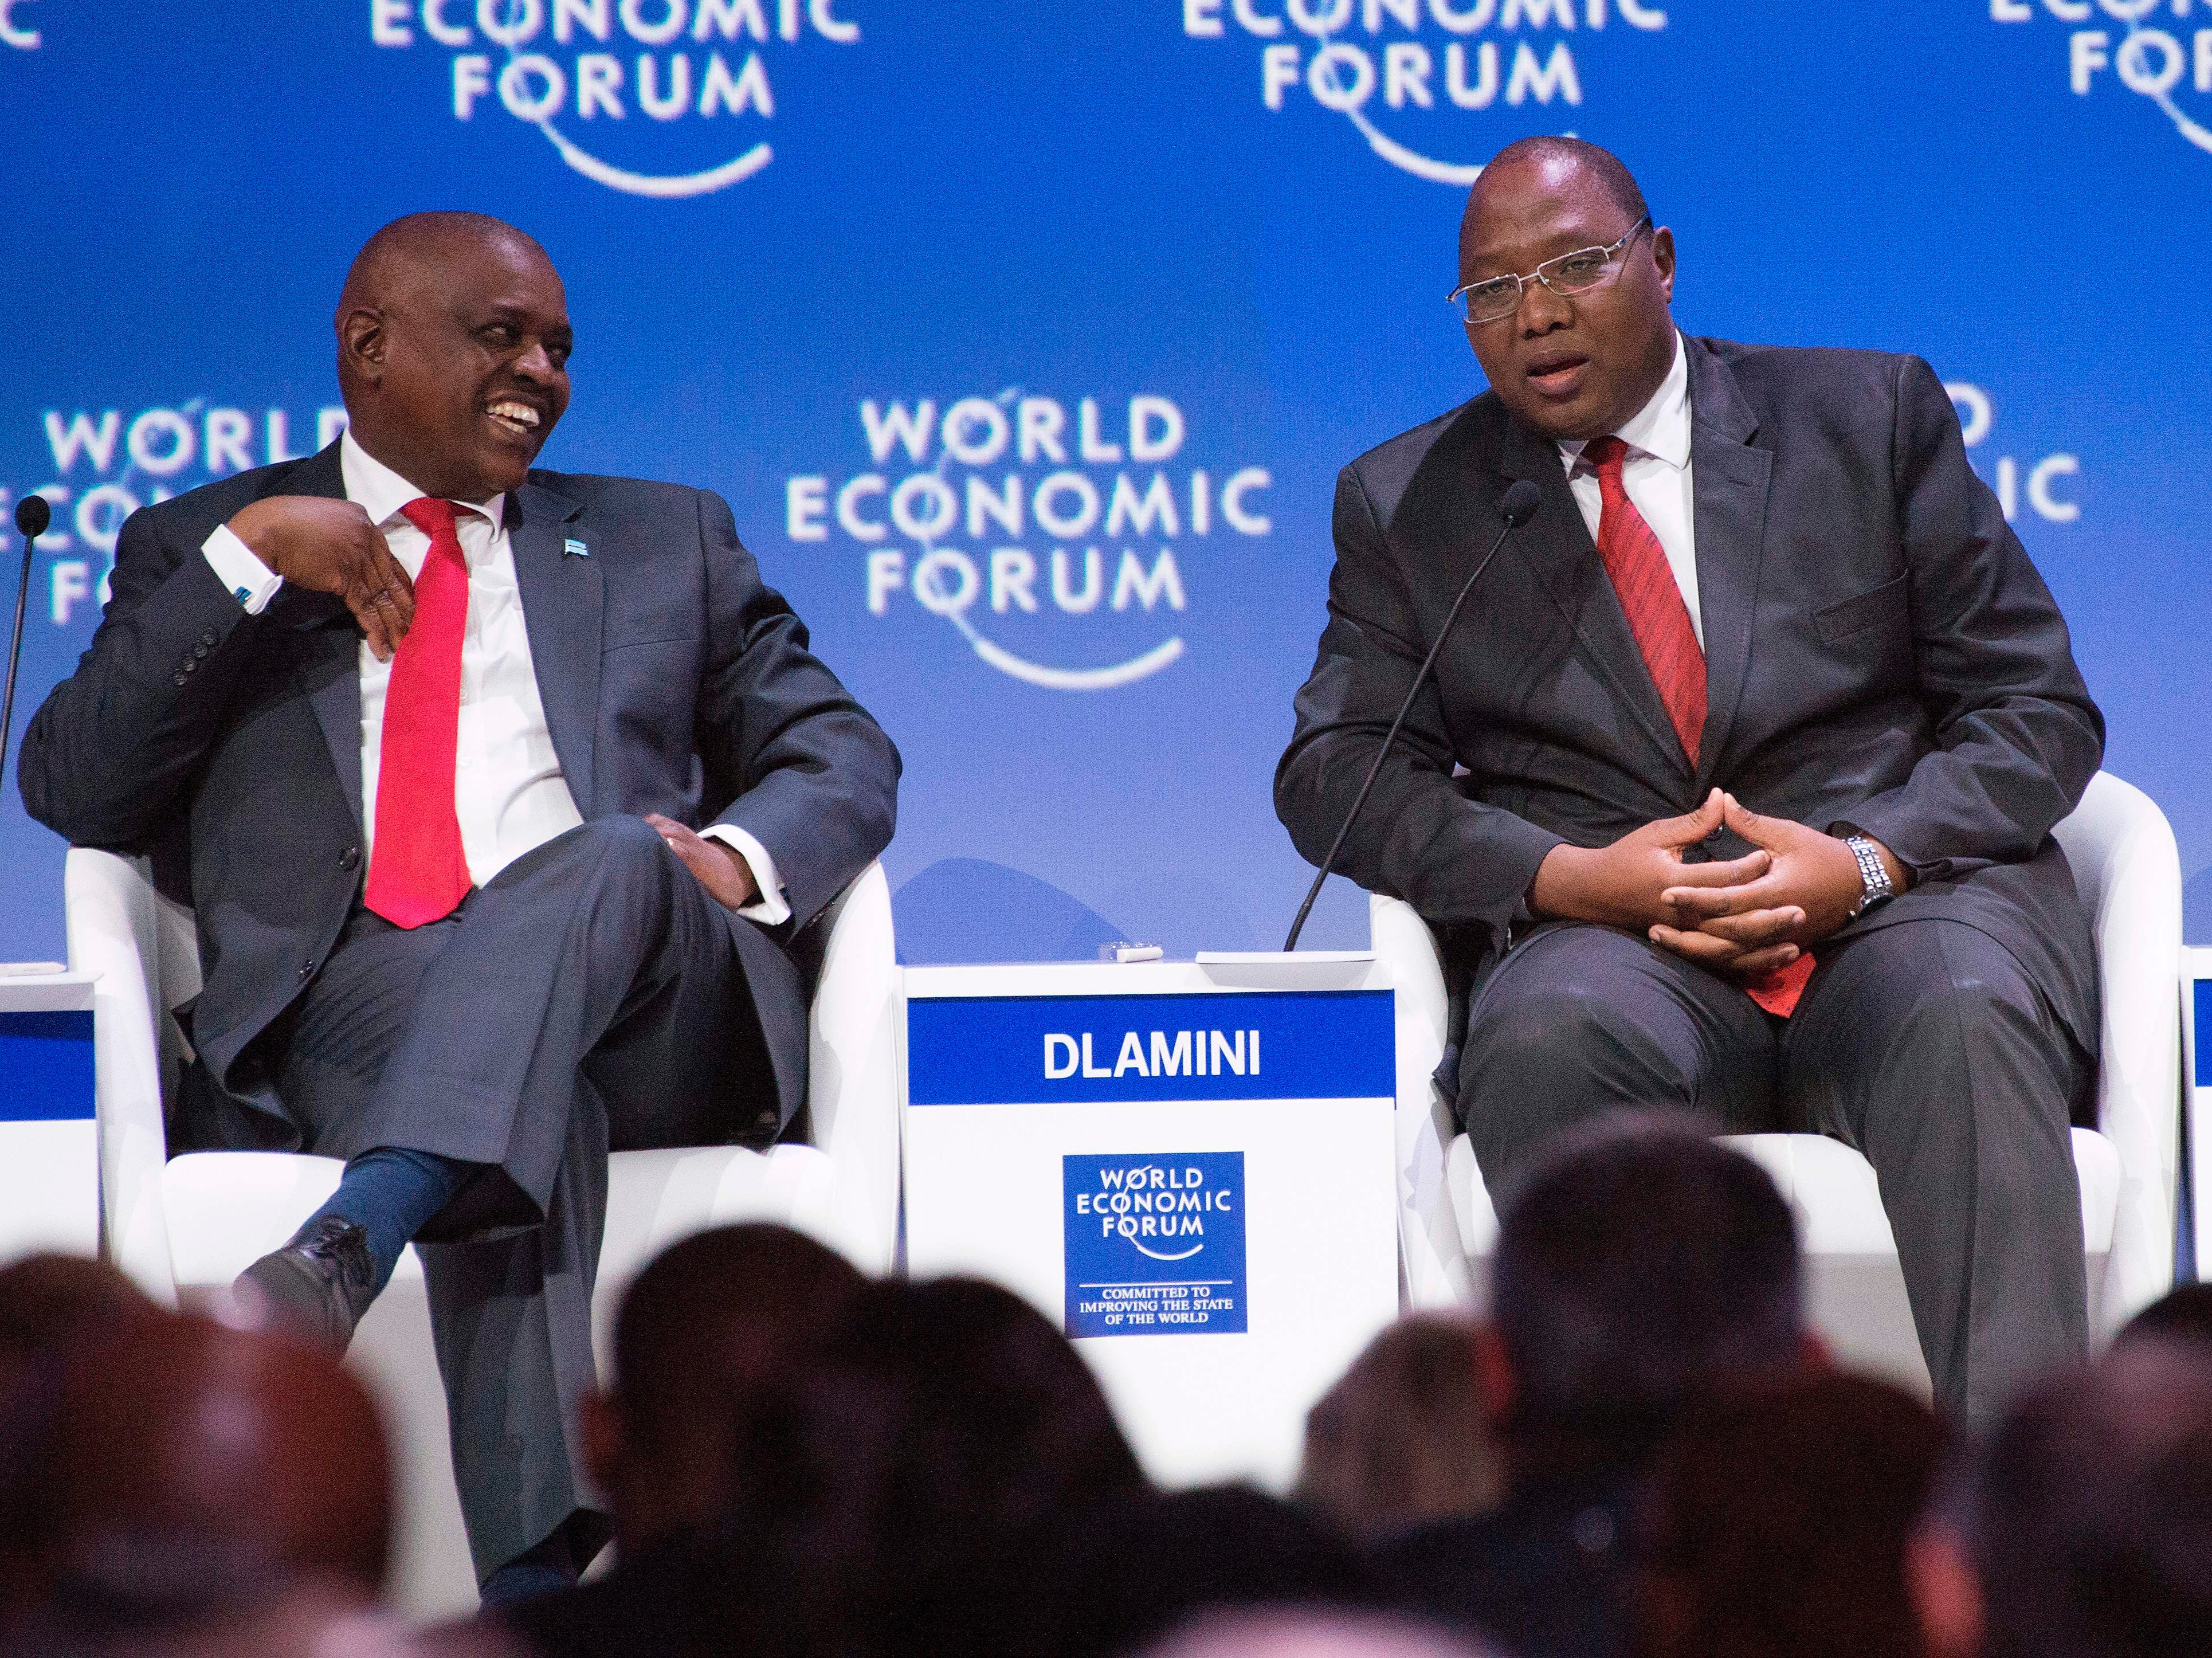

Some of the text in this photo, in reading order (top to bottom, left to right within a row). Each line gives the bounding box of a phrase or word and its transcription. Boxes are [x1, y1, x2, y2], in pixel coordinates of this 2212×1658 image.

[371, 0, 860, 47] ECONOMIC
[453, 53, 774, 120] FORUM
[1262, 42, 1583, 111] FORUM
[861, 395, 1186, 465] WORLD
[787, 468, 1272, 542] ECONOMIC
[868, 547, 1186, 616] FORUM
[1044, 1030, 1260, 1080] DLAMINI
[1077, 1190, 1231, 1214] ECONOMIC
[1100, 1167, 1203, 1190] WORLD
[1103, 1215, 1203, 1237] FORUM
[1080, 1299, 1233, 1313] IMPROVING THE STATE
[1102, 1287, 1210, 1299] COMMITTED TO
[1105, 1312, 1209, 1325] OF THE WORLD
